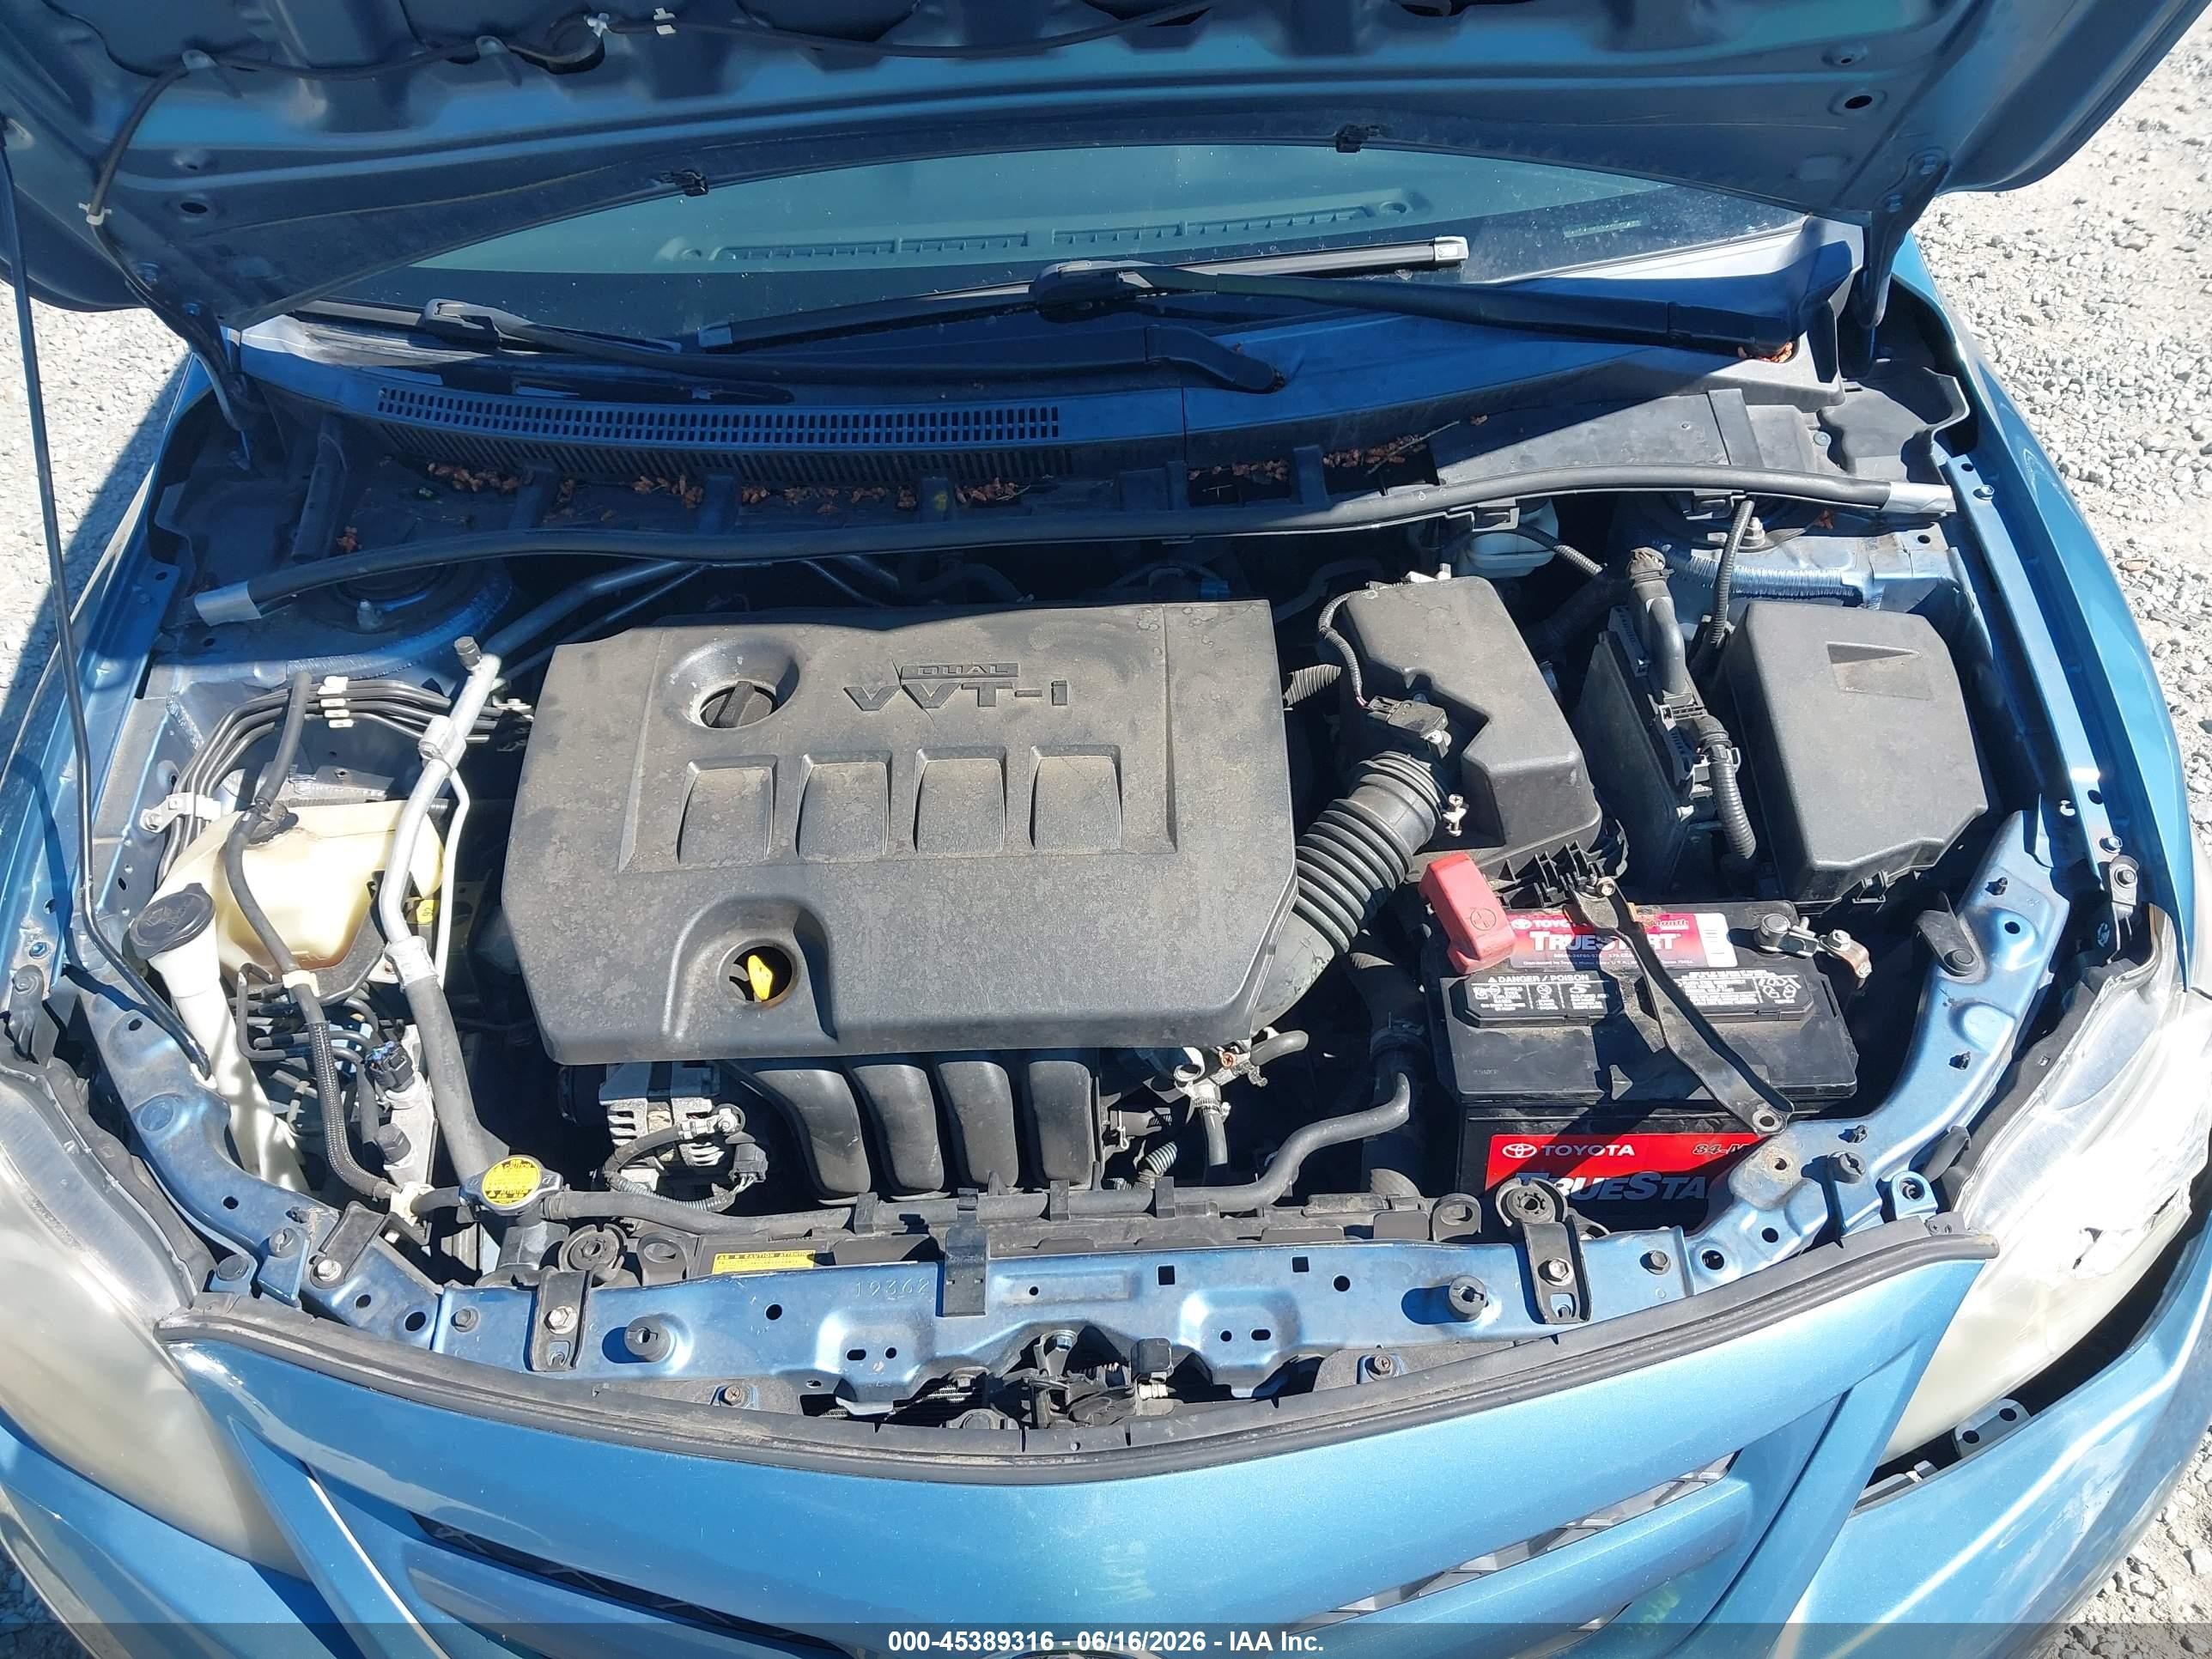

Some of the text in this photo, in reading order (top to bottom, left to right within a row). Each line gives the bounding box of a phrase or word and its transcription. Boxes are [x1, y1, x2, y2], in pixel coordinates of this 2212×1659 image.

[917, 665, 1009, 675] DUAL
[1498, 975, 1540, 983] DANGER
[1540, 1144, 1636, 1157] TOYOTA
